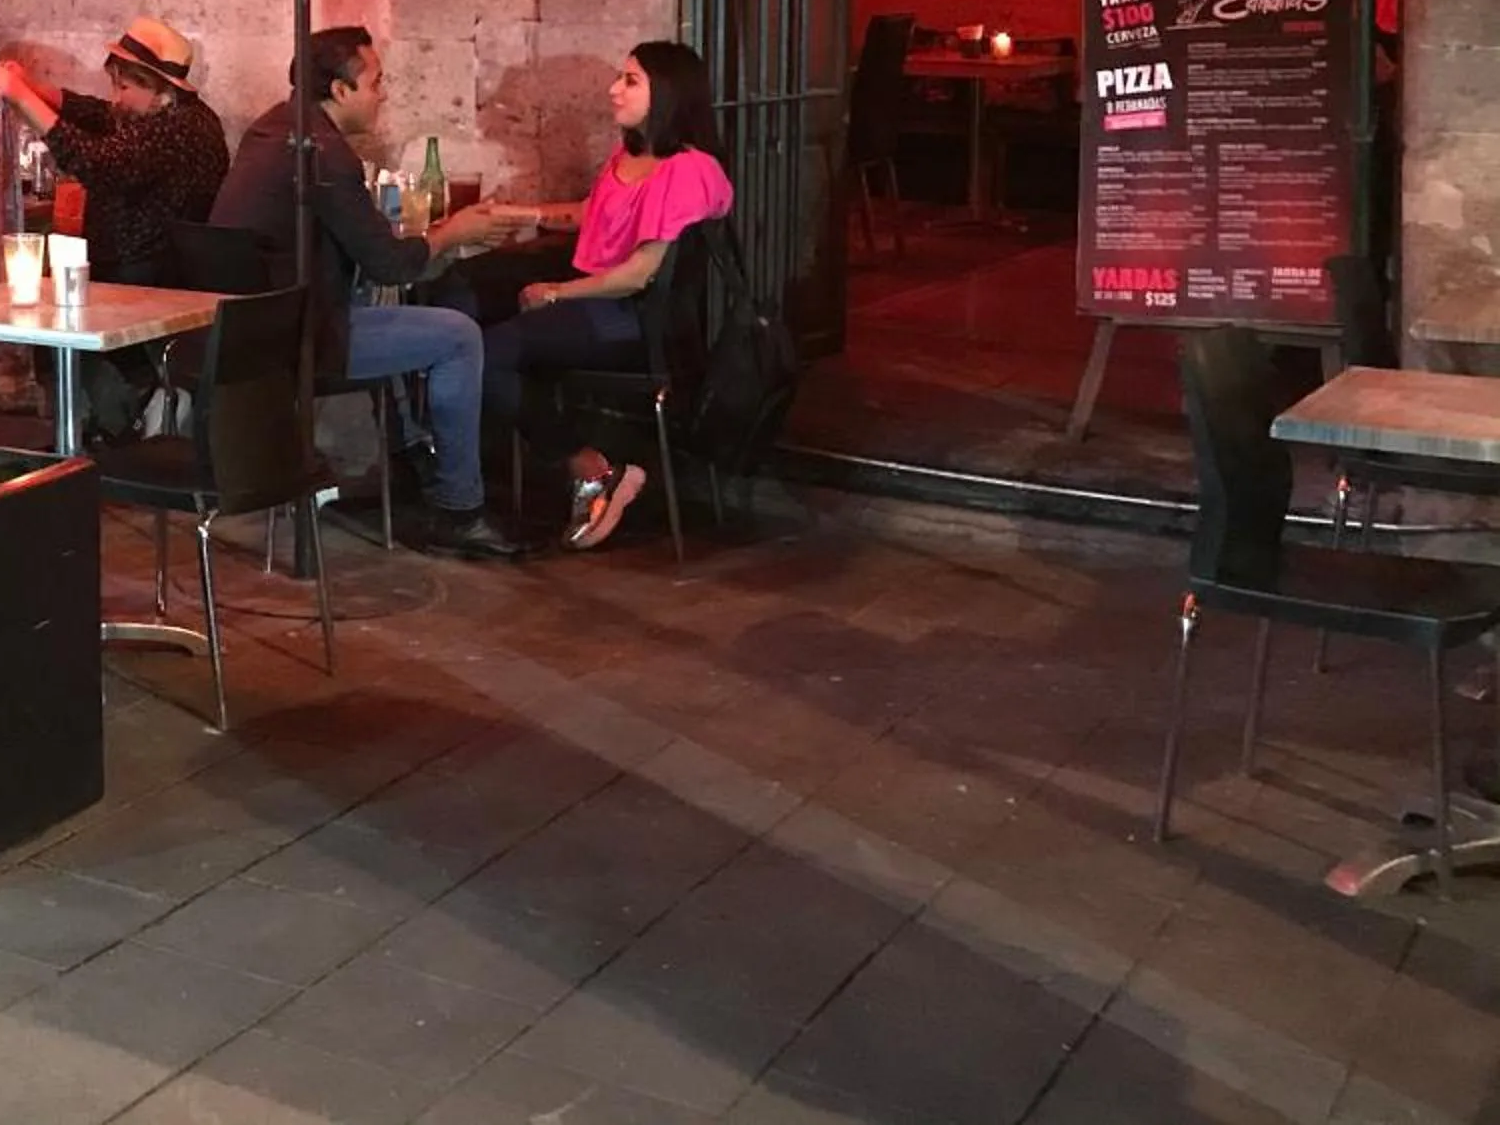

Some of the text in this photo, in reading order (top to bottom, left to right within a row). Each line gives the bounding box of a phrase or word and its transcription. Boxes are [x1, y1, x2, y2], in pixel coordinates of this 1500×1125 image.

[1103, 3, 1155, 31] $100
[1106, 25, 1159, 45] CERVEZA
[1096, 62, 1174, 98] PIZZA
[1092, 266, 1178, 290] YARDAS
[1145, 291, 1177, 307] $125
